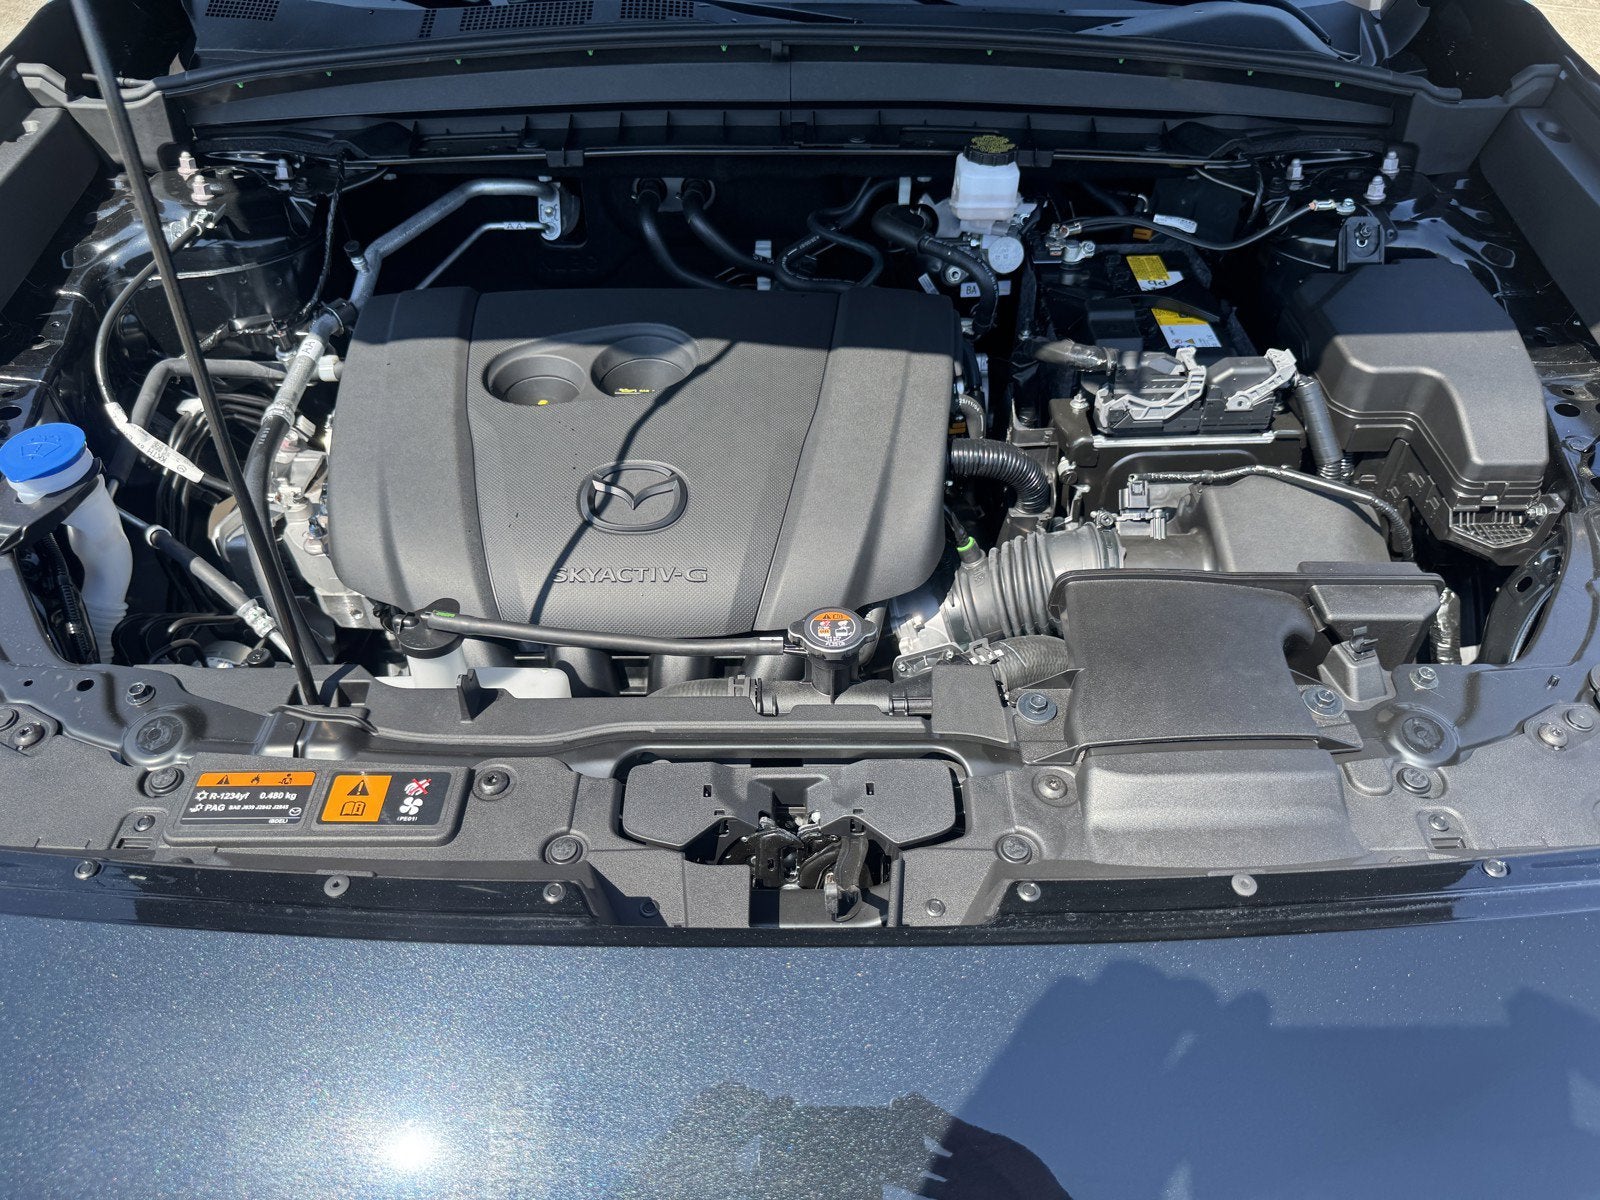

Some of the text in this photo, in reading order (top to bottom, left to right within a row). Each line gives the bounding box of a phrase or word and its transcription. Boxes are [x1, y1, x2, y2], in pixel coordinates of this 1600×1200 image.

[966, 285, 977, 295] BA
[553, 566, 708, 583] SKYACTIV-G
[208, 791, 298, 801] R-1234yf 0.480 kg
[204, 803, 226, 812] PAG
